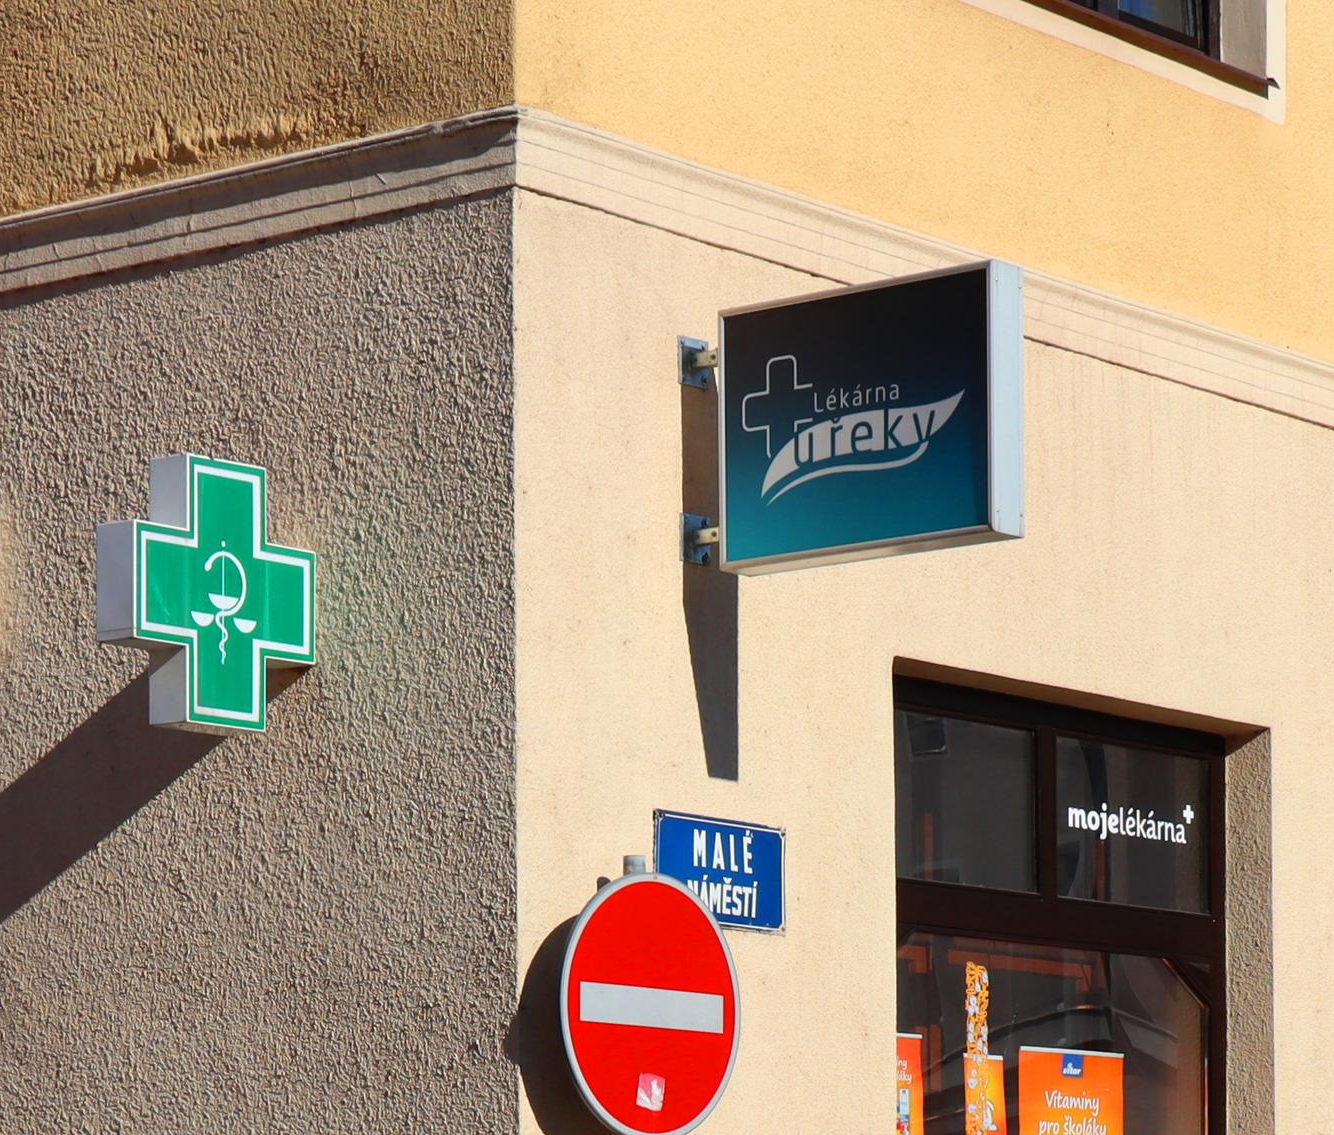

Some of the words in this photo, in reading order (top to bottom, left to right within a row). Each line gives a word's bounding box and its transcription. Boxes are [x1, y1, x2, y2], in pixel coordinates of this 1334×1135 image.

[813, 384, 900, 412] Lékárna
[1068, 802, 1187, 844] mojelékárna
[693, 828, 754, 874] MALÉ
[1045, 1089, 1100, 1117] Vitaminy
